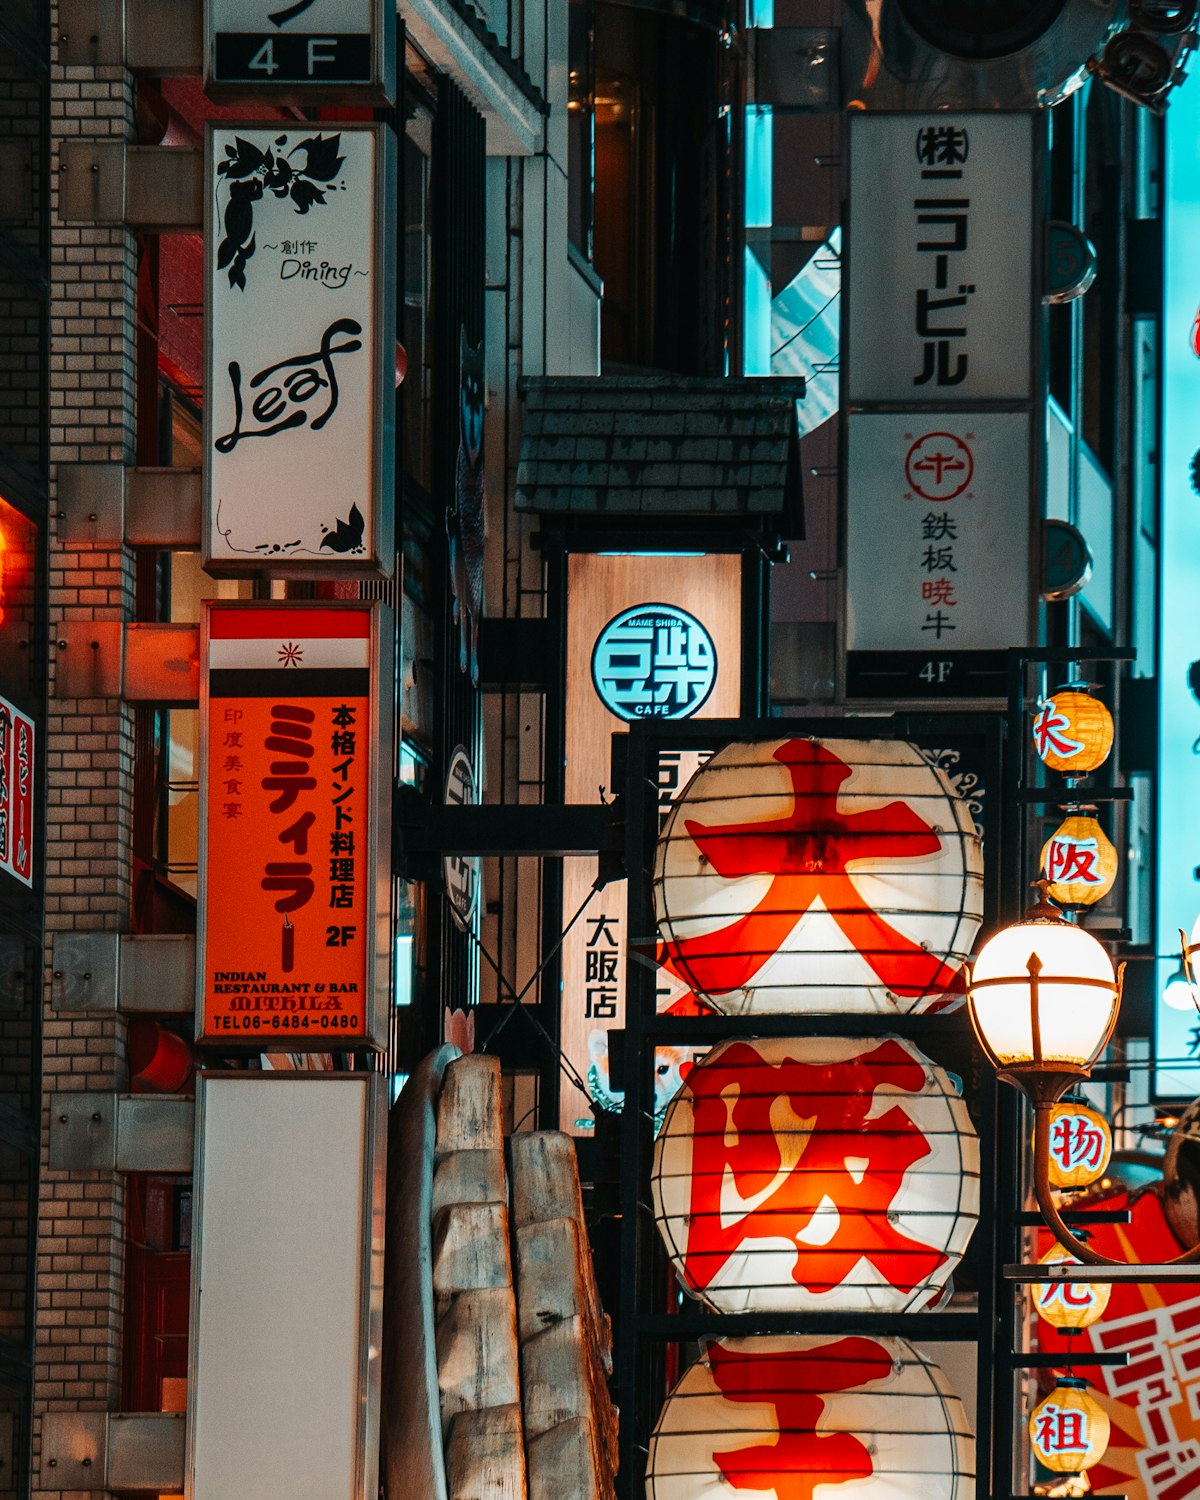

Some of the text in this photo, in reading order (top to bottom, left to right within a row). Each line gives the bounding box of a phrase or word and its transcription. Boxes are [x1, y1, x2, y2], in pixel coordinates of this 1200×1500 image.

[1055, 242, 1076, 277] 5
[214, 318, 363, 452] Leaf
[920, 511, 959, 640] 鉄板暁牛
[628, 618, 684, 627] MAME SHIBA
[599, 626, 714, 704] 豆柴
[919, 661, 954, 683] 4F
[634, 704, 670, 715] CAFE
[221, 707, 244, 820] 印度美食宴
[329, 703, 357, 909] 本格インド料理店
[260, 704, 318, 973] ミティラー
[325, 925, 357, 948] 2F
[213, 971, 267, 982] INDIAN
[213, 982, 359, 994] RESTAURANT & BAR
[584, 914, 620, 1019] 大阪店
